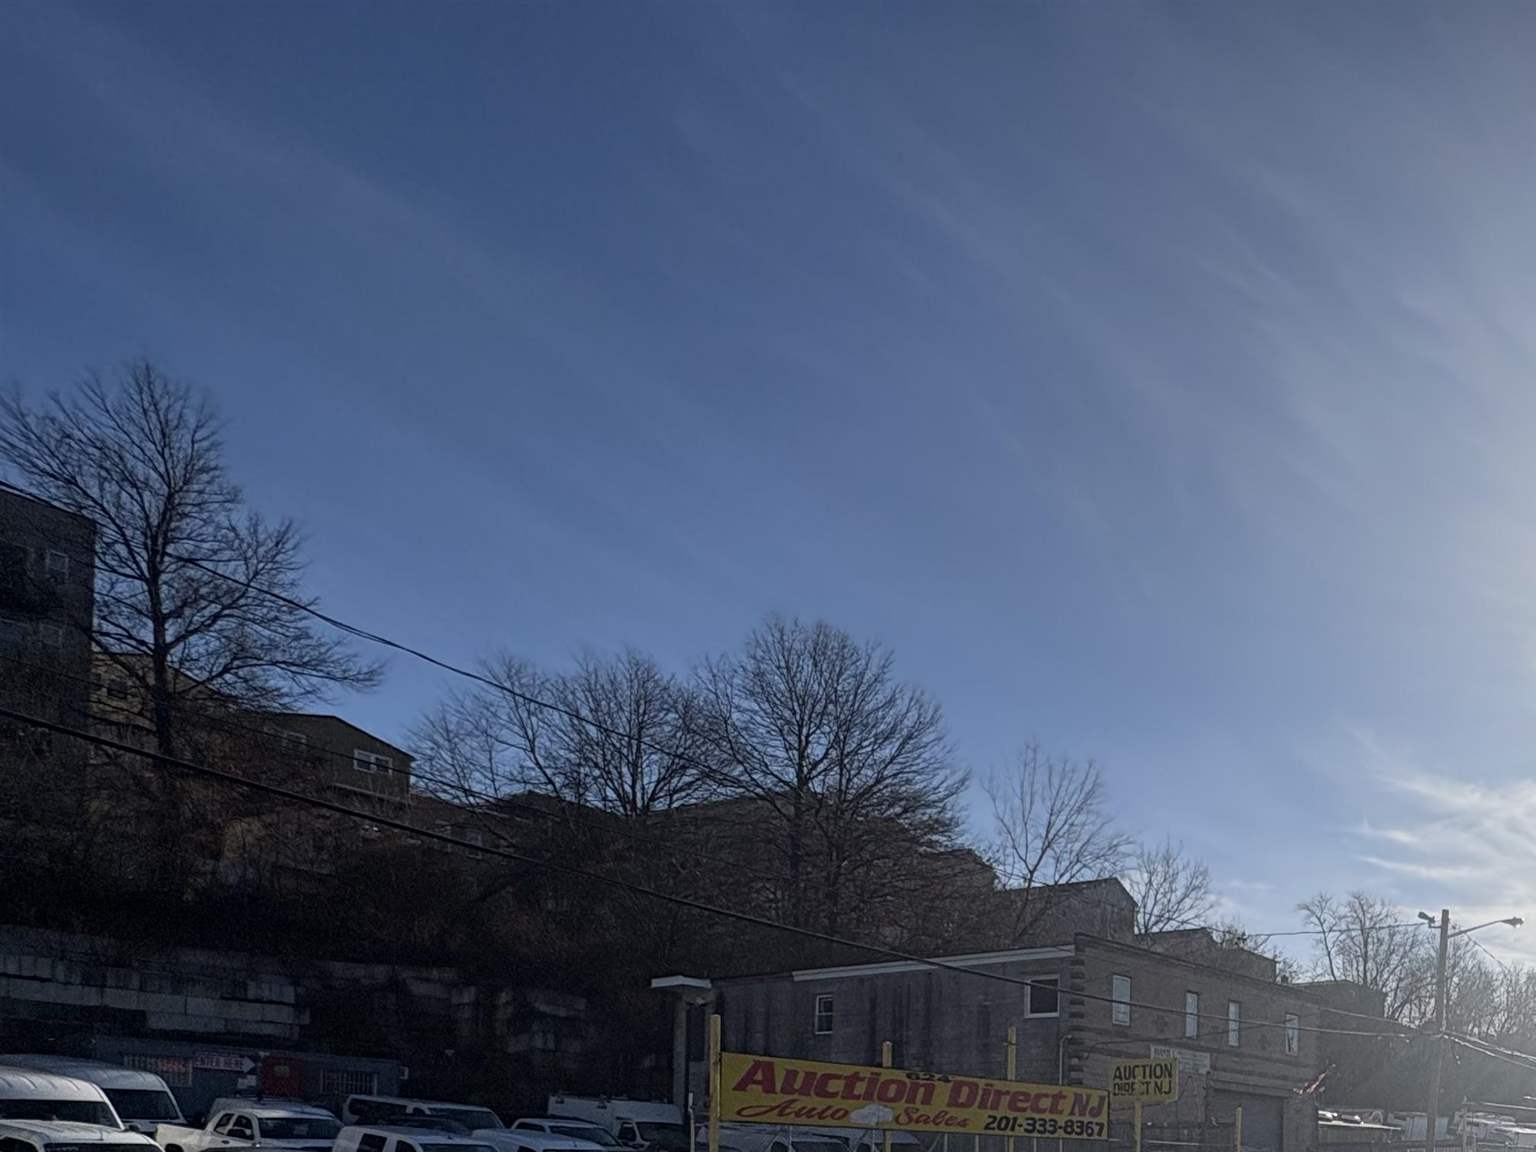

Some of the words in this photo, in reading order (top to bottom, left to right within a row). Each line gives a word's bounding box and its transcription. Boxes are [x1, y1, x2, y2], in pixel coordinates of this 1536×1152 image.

[1113, 1064, 1172, 1082] AUCTION
[733, 1060, 936, 1105] Auction
[947, 1079, 1066, 1115] Direct
[1070, 1092, 1107, 1118] NJ
[1154, 1080, 1172, 1096] NJ
[736, 1099, 848, 1120] Auto
[895, 1106, 972, 1128] Sales
[984, 1115, 1104, 1138] 201-333-8367
